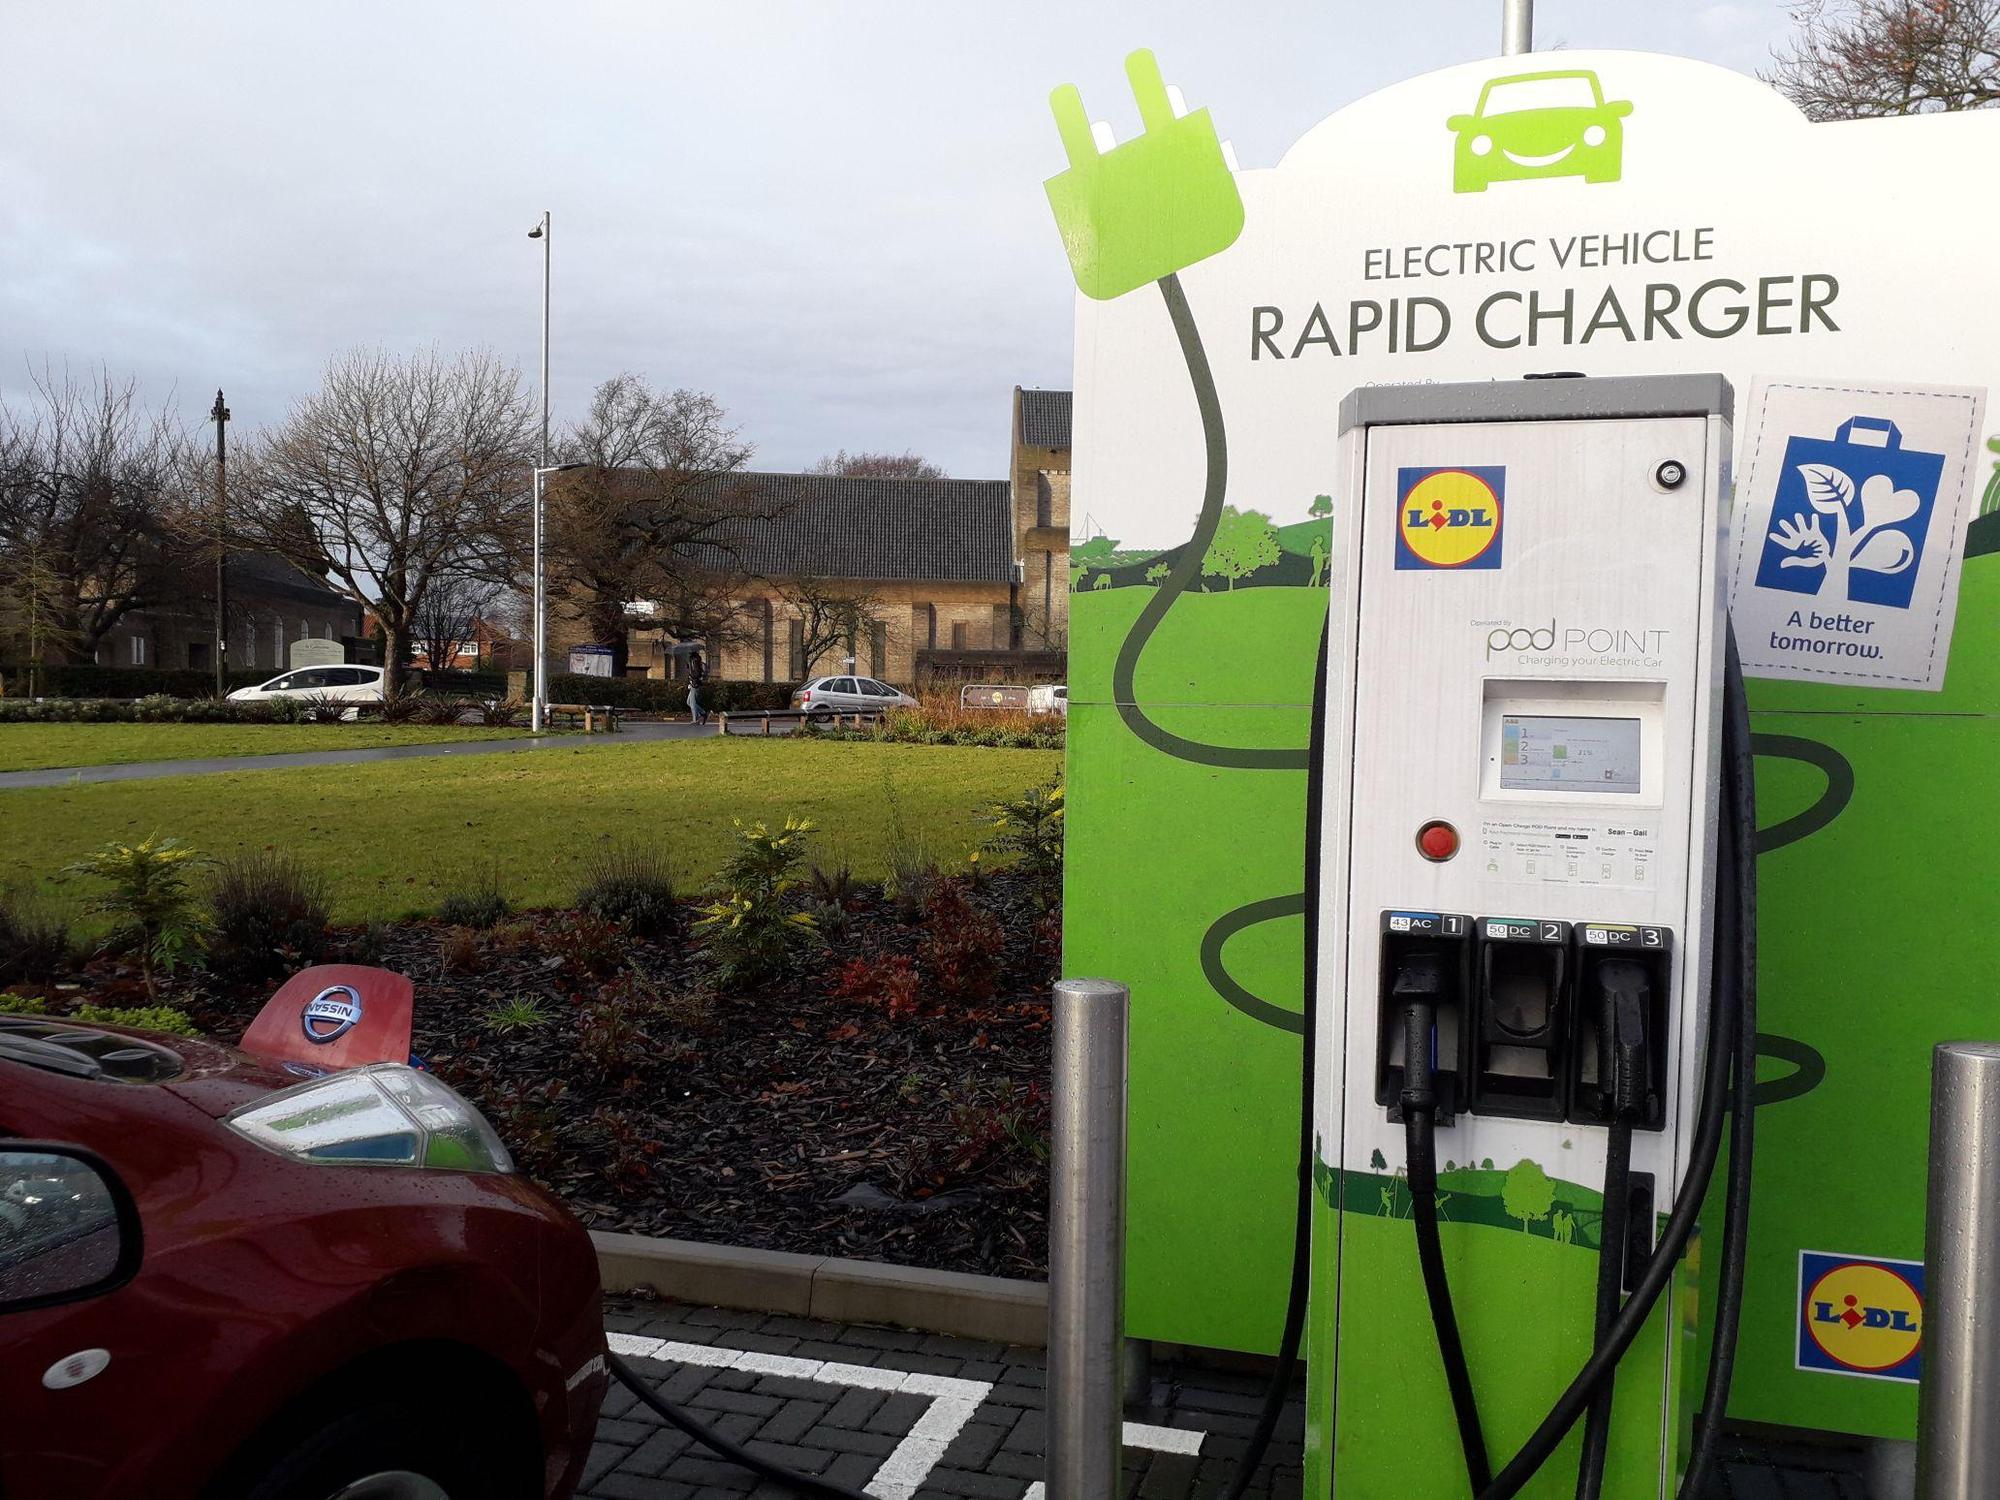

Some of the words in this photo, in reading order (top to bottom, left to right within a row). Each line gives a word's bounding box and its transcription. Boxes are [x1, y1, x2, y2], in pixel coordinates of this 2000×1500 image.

[1363, 239, 1536, 281] ELECTRIC
[1549, 228, 1714, 269] VEHICLE
[1250, 296, 1452, 361] RAPID
[1475, 273, 1842, 350] CHARGER
[1787, 611, 1802, 627] A
[1809, 611, 1875, 634] better
[1486, 617, 1556, 662] pod
[1564, 629, 1671, 654] POINT
[1769, 631, 1884, 659] tomorrow.
[1518, 655, 1570, 667] Charging
[1572, 657, 1598, 667] your
[1600, 655, 1641, 667] Electric
[1643, 658, 1663, 668] Car
[1521, 728, 1528, 738] 1
[1520, 741, 1528, 752] 2
[1520, 754, 1528, 765] 3
[1607, 828, 1626, 836] Sean
[1633, 829, 1648, 837] Gail
[1392, 918, 1409, 927] 43
[1411, 919, 1432, 929] AC
[1448, 917, 1457, 933] 1
[1489, 924, 1506, 934] 50
[1509, 926, 1531, 936] DC
[1544, 924, 1560, 940] 2
[1589, 930, 1606, 940] 50
[1609, 931, 1631, 941] DC
[1645, 930, 1660, 945] 3
[307, 1002, 353, 1018] NISSAN
